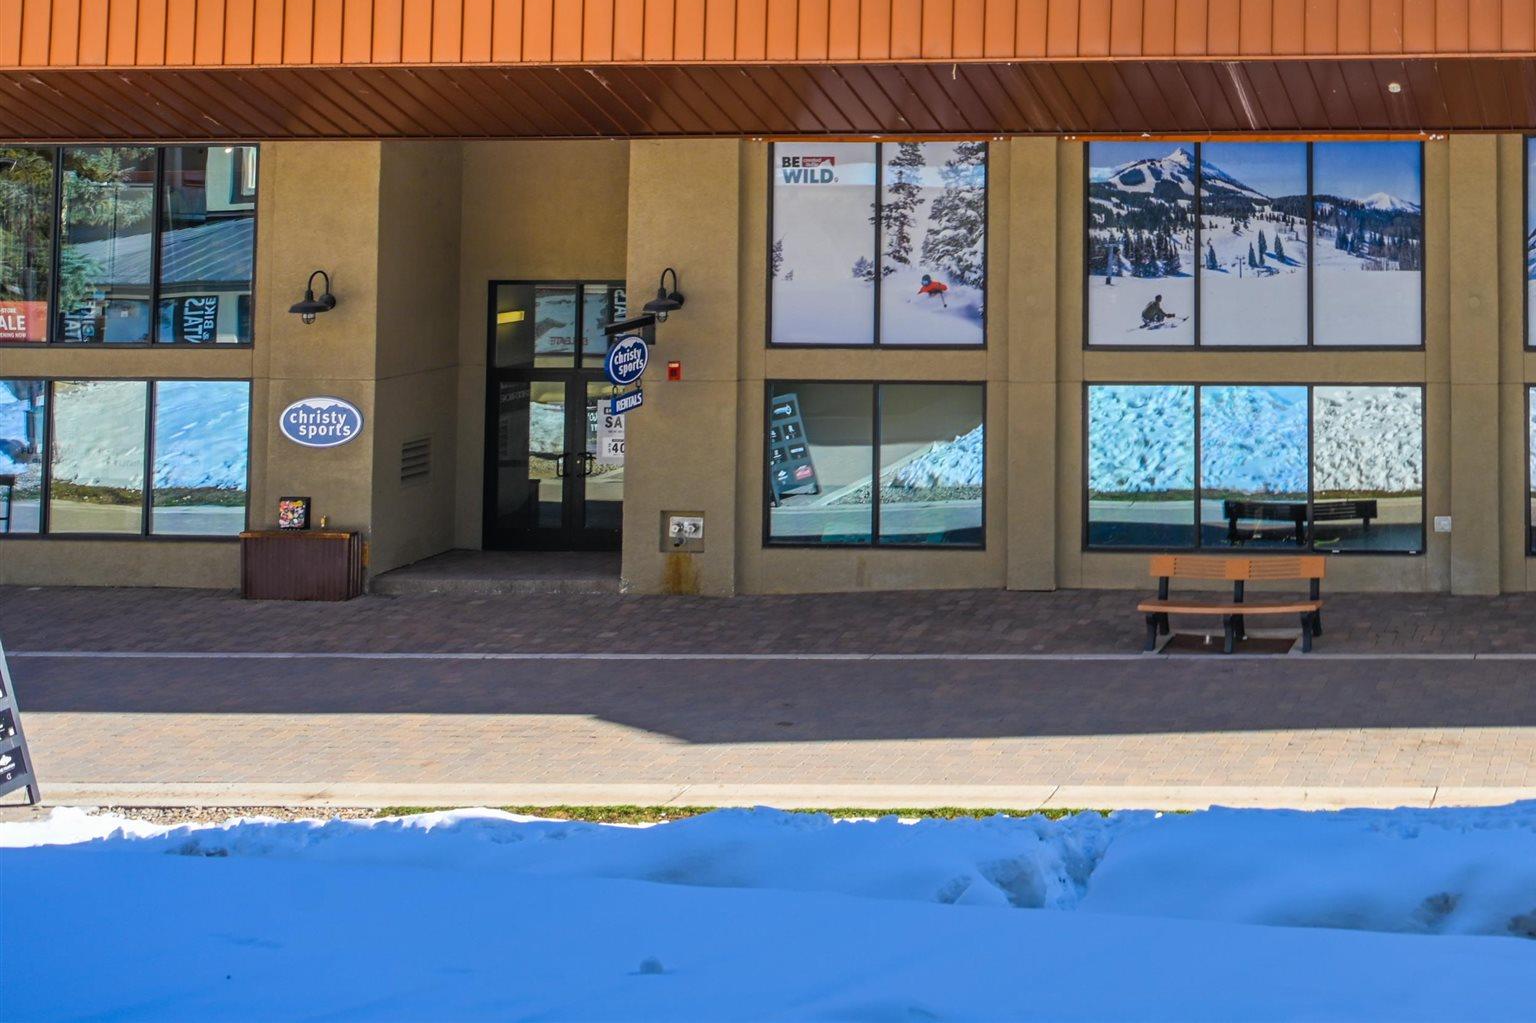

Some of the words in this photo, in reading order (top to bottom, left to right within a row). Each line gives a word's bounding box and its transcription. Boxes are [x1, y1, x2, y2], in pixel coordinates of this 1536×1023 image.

[782, 157, 800, 167] BE
[782, 169, 834, 183] WILD
[614, 347, 642, 365] christy
[618, 358, 644, 378] sports
[616, 392, 643, 413] RENTALS
[289, 409, 346, 428] christy
[298, 423, 351, 439] sports
